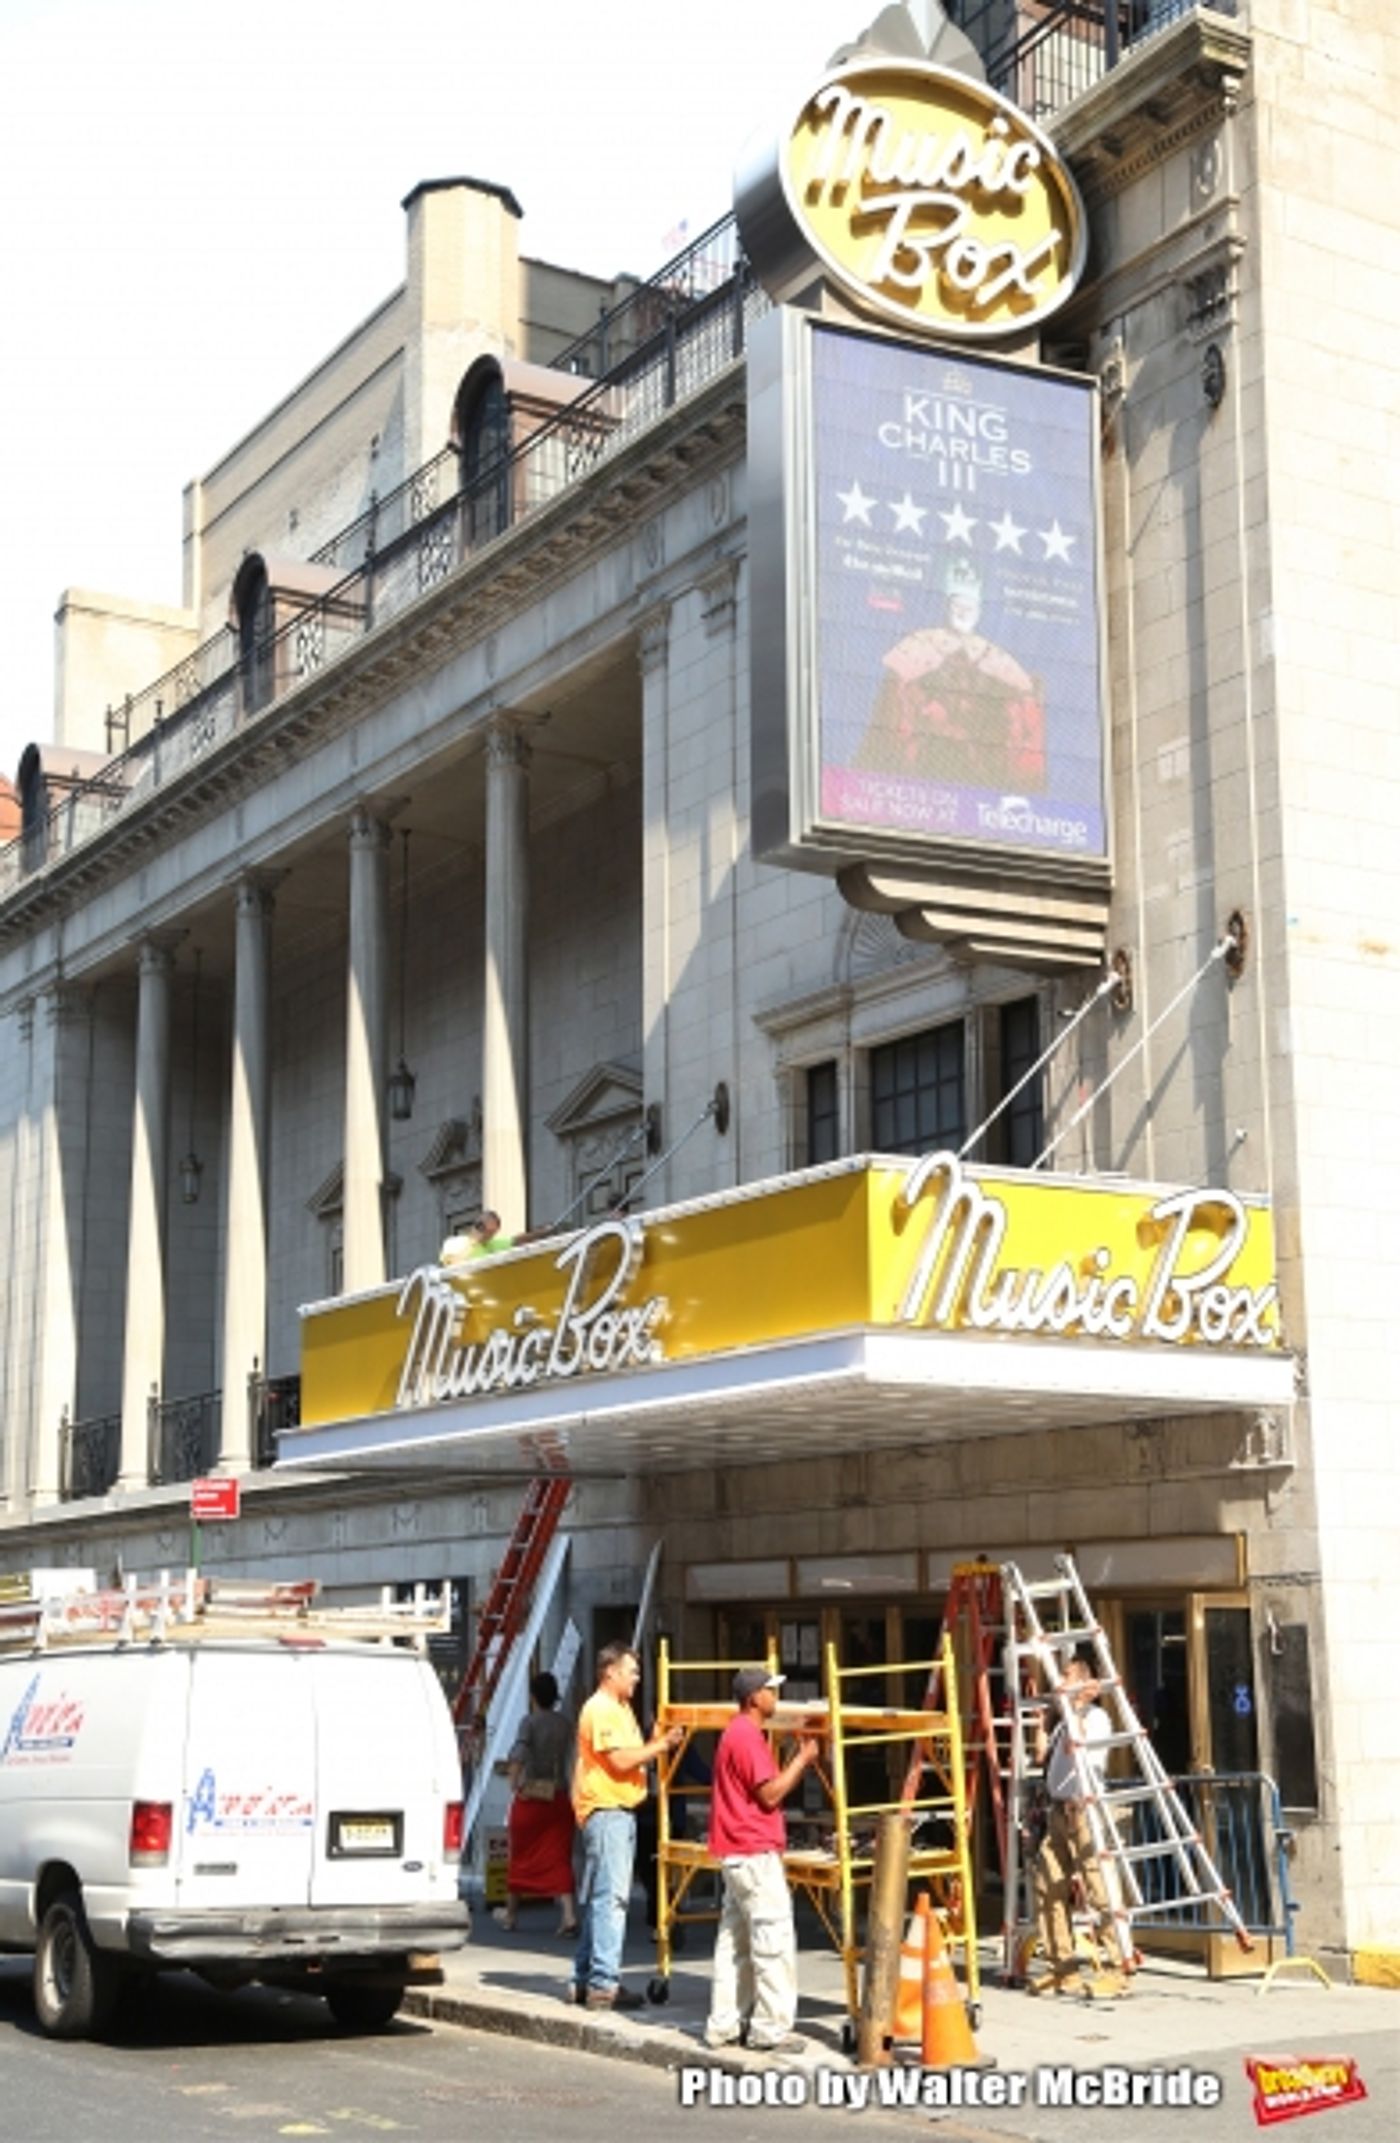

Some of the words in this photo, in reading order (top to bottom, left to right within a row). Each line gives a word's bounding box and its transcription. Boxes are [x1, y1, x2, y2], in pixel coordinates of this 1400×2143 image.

[815, 84, 1042, 194] Music
[856, 190, 1064, 306] Box
[877, 420, 1032, 475] CHARLES
[904, 393, 1009, 443] KING
[938, 458, 976, 493] III
[976, 801, 1087, 842] Telecharge
[904, 1150, 1137, 1336] Music
[1142, 1188, 1280, 1344] Box
[396, 1265, 552, 1408] Music
[545, 1220, 668, 1376] Box
